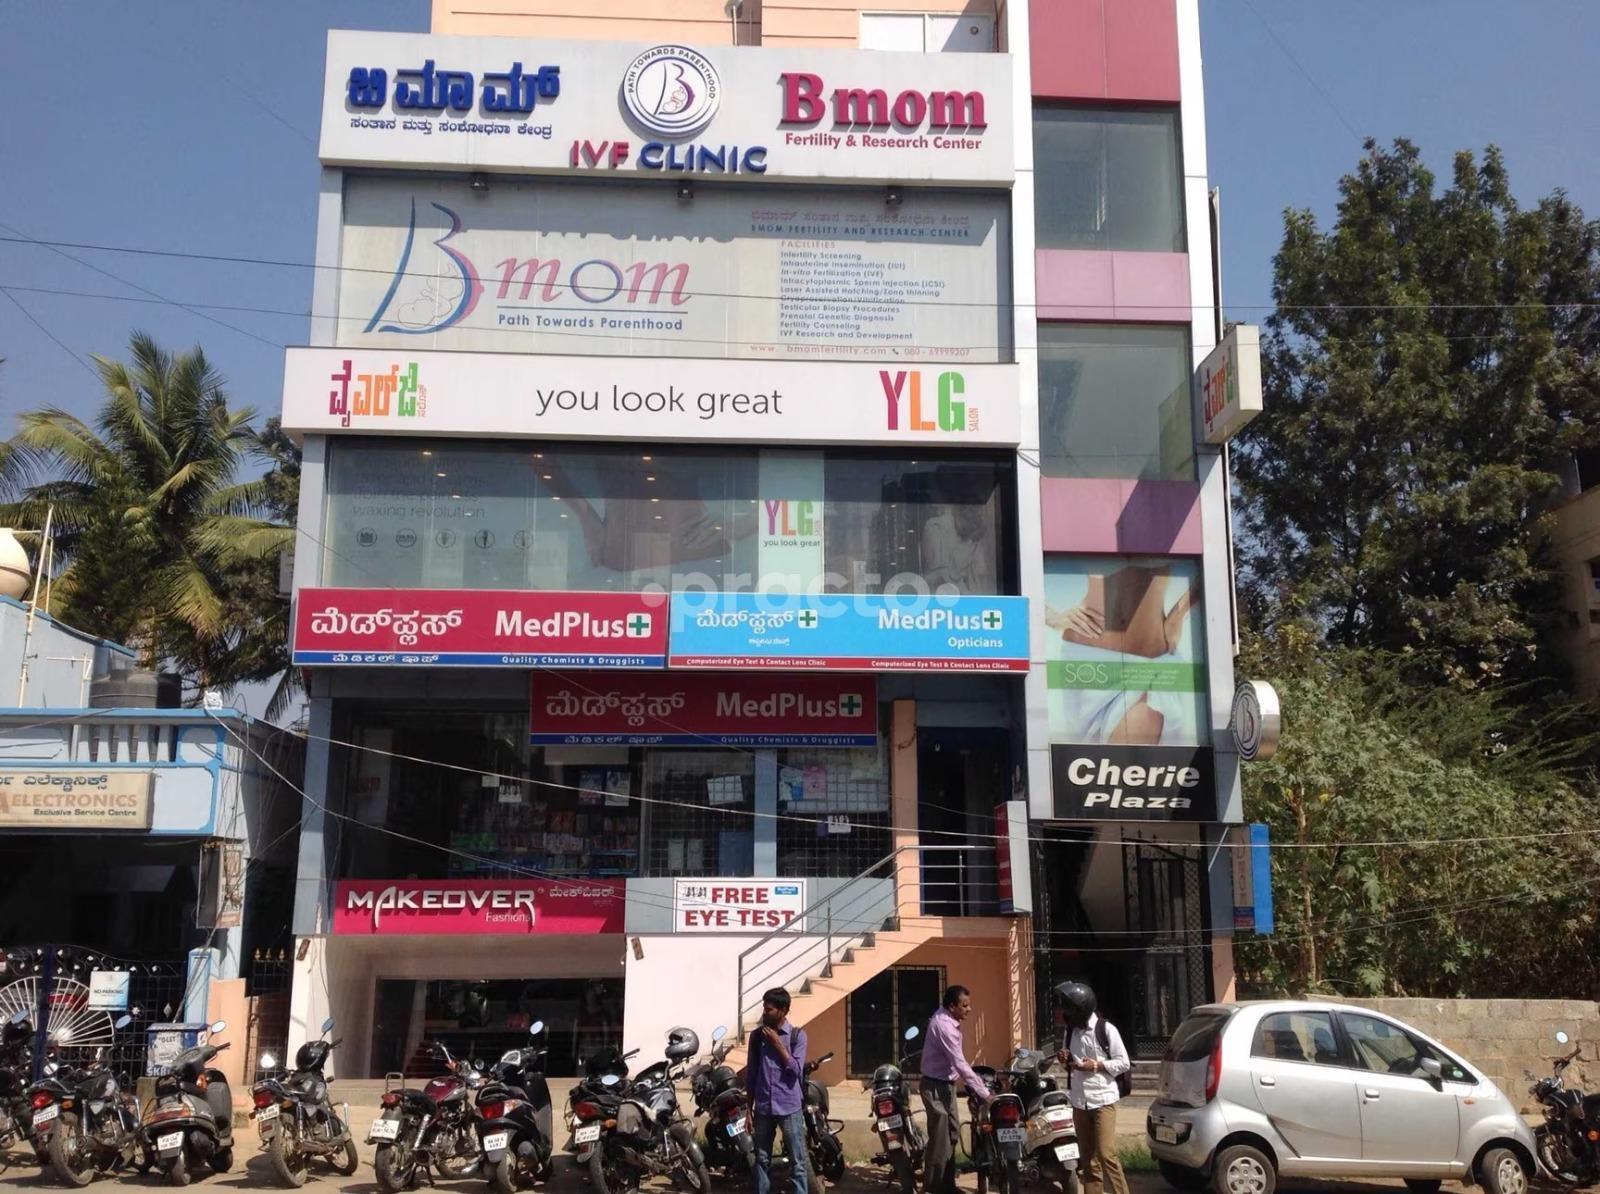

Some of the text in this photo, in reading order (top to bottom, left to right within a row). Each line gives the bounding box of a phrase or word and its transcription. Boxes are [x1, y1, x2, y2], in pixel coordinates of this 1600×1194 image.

[634, 48, 675, 69] TOWARDS
[679, 50, 716, 99] PARENTHOOD
[780, 73, 987, 127] Bmom
[403, 119, 432, 134] ಮತ್ತು
[785, 133, 982, 150] Fertility & Research Center
[572, 140, 767, 173] IVF CLINIC
[789, 225, 838, 234] FERTILITY
[844, 227, 865, 235] AND
[871, 228, 924, 236] RESEARCH
[930, 229, 969, 238] CENTER
[781, 240, 835, 248] FACILITIES
[781, 251, 862, 260] Infertility Screening
[864, 270, 884, 278] (IVF)
[781, 303, 899, 313] Testicular Biopsy Procedures
[499, 314, 682, 330] Path Towards Parenthood
[781, 312, 815, 320] Prenatal
[854, 314, 894, 322] Diagnosis
[781, 321, 860, 330] Fertility Counseling
[856, 331, 912, 339] Development
[536, 385, 782, 420] you look great
[879, 371, 965, 432] YLG
[969, 407, 979, 432] SALON
[764, 499, 813, 536] YLG
[799, 540, 820, 548] great
[495, 609, 626, 639] MedPlus
[879, 608, 982, 630] MedPlus
[948, 636, 1003, 649] Opticians
[502, 656, 537, 664] Quality
[541, 656, 585, 664] Chemists
[599, 657, 645, 665] Druggists
[687, 658, 731, 666] Computerized
[871, 660, 916, 668] Computerized
[1065, 663, 1108, 683] SOS
[716, 692, 838, 717] MedPlus
[721, 736, 754, 745] Quality
[758, 736, 798, 744] Chemists
[811, 737, 855, 745] Druggists
[1067, 757, 1200, 788] Cherie
[12, 794, 137, 807] ELECTRONICS
[1084, 789, 1191, 809] Plaza
[34, 808, 72, 816] Exclusive
[74, 808, 105, 816] Service
[712, 887, 769, 904] FREE
[348, 886, 536, 927] MAKEOVER
[685, 909, 795, 927] EYE TEST
